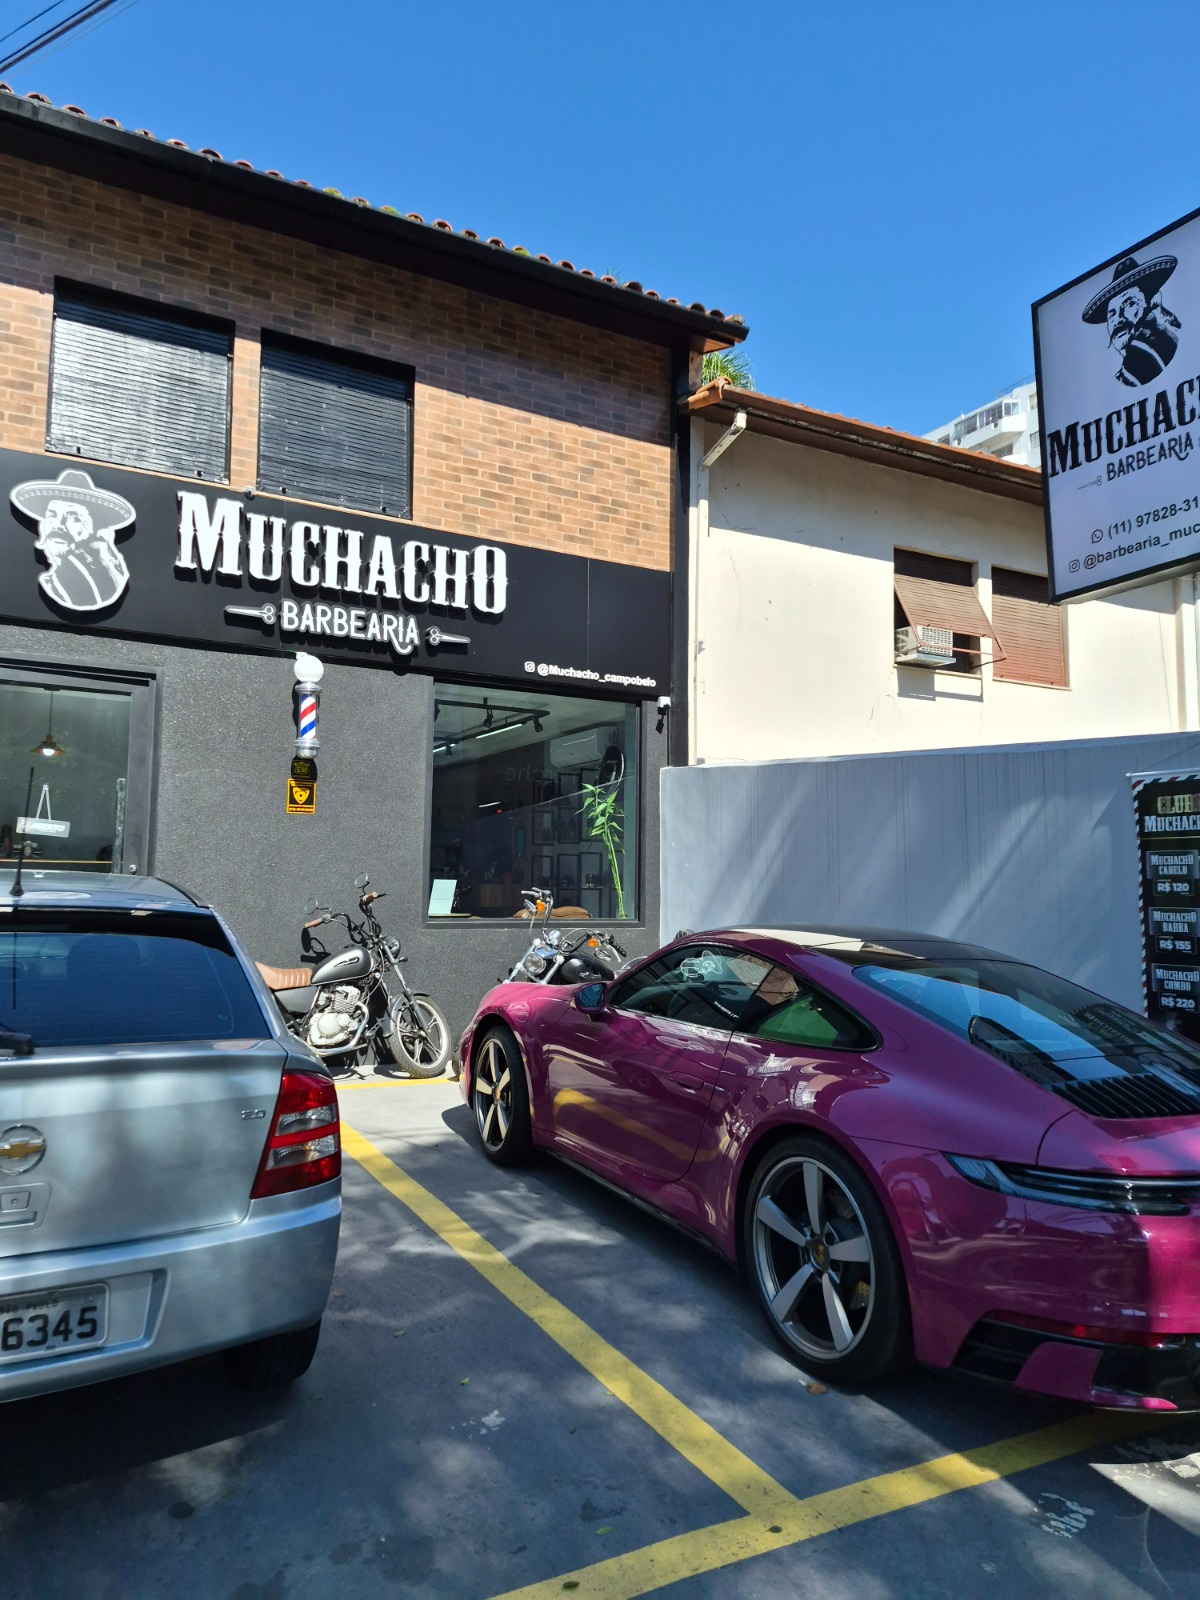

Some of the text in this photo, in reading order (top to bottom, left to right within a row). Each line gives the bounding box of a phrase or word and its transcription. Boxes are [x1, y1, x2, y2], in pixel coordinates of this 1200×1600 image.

[1047, 374, 1200, 478] MUCHAC
[1106, 431, 1194, 482] BARBEARIA
[1108, 495, 1199, 540] (11) 97828-31
[174, 490, 508, 614] MUCHACHO
[281, 600, 419, 655] BARBEARIA
[537, 663, 656, 687] @Muchacho_campobelo
[1150, 854, 1194, 866] MUCHACHO
[1157, 882, 1190, 893] R$ 120
[1153, 910, 1197, 923] MUCHACHO
[1162, 922, 1189, 933] BARBA
[1159, 939, 1192, 950] R$ 155
[1161, 996, 1196, 1009] R$ 220
[1, 1305, 98, 1352] 6345
